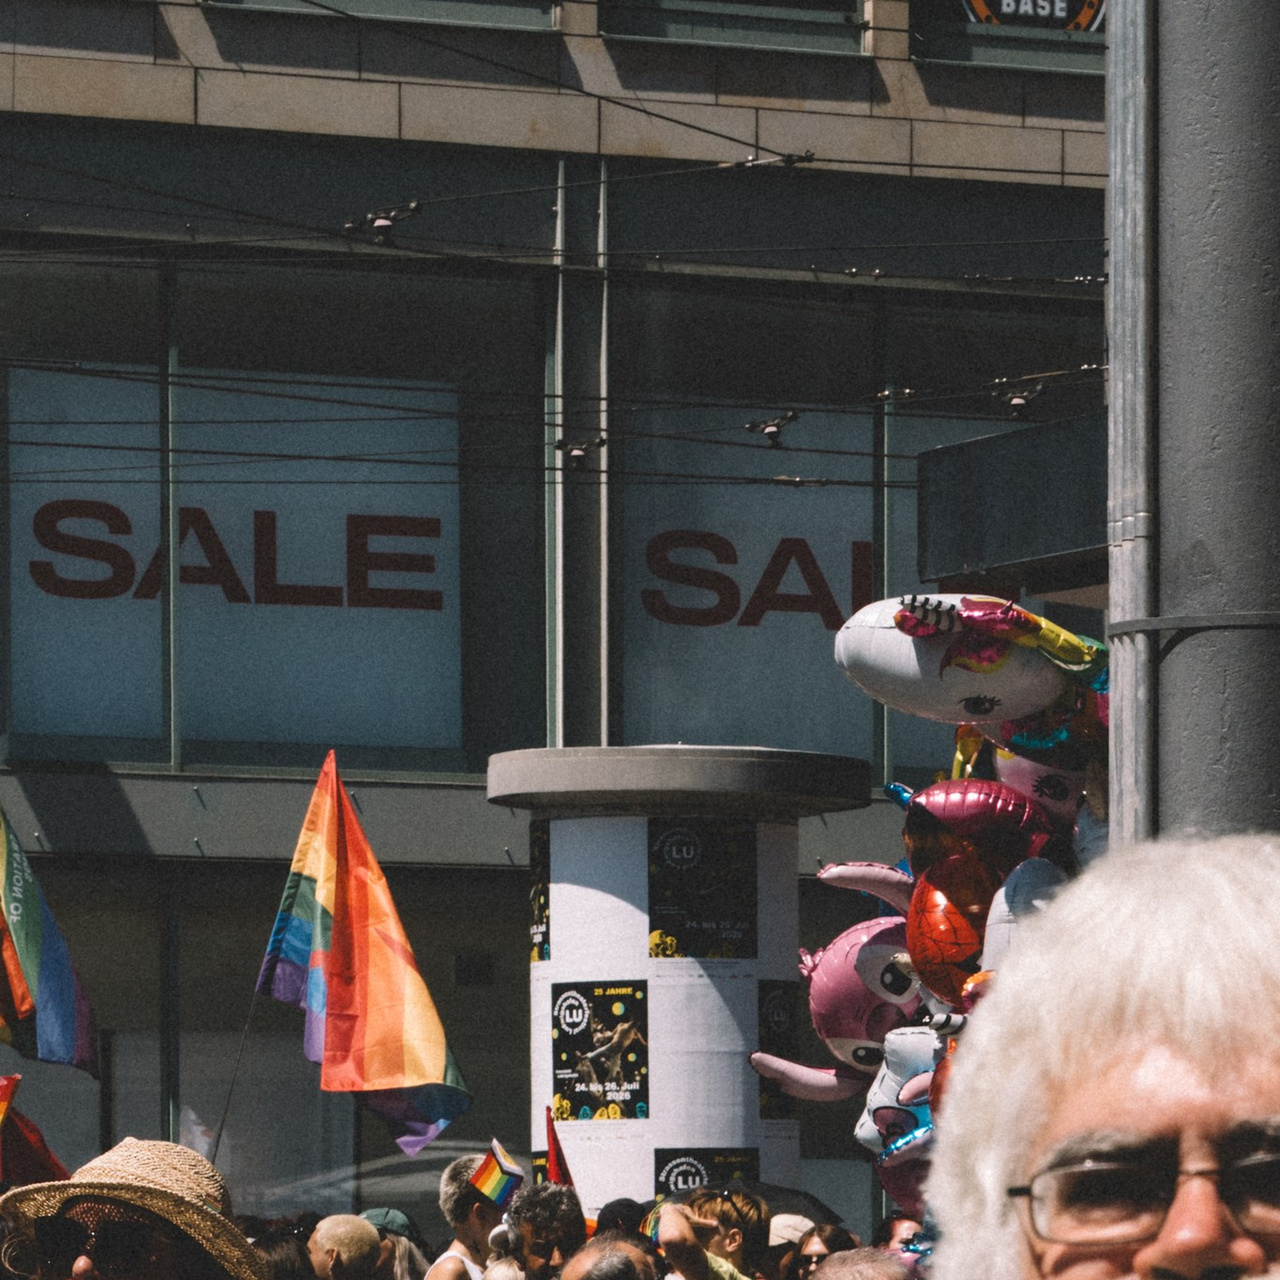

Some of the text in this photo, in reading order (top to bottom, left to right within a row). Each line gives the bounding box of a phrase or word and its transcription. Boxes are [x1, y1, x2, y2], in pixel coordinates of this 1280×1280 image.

[28, 499, 444, 611] SALE
[605, 987, 633, 996] JAHRE
[565, 1009, 583, 1023] LU
[575, 1082, 588, 1092] 24.
[604, 1082, 620, 1091] 26.
[621, 1082, 640, 1091] Juli
[606, 1091, 631, 1101] 2026
[677, 1175, 700, 1190] LU
